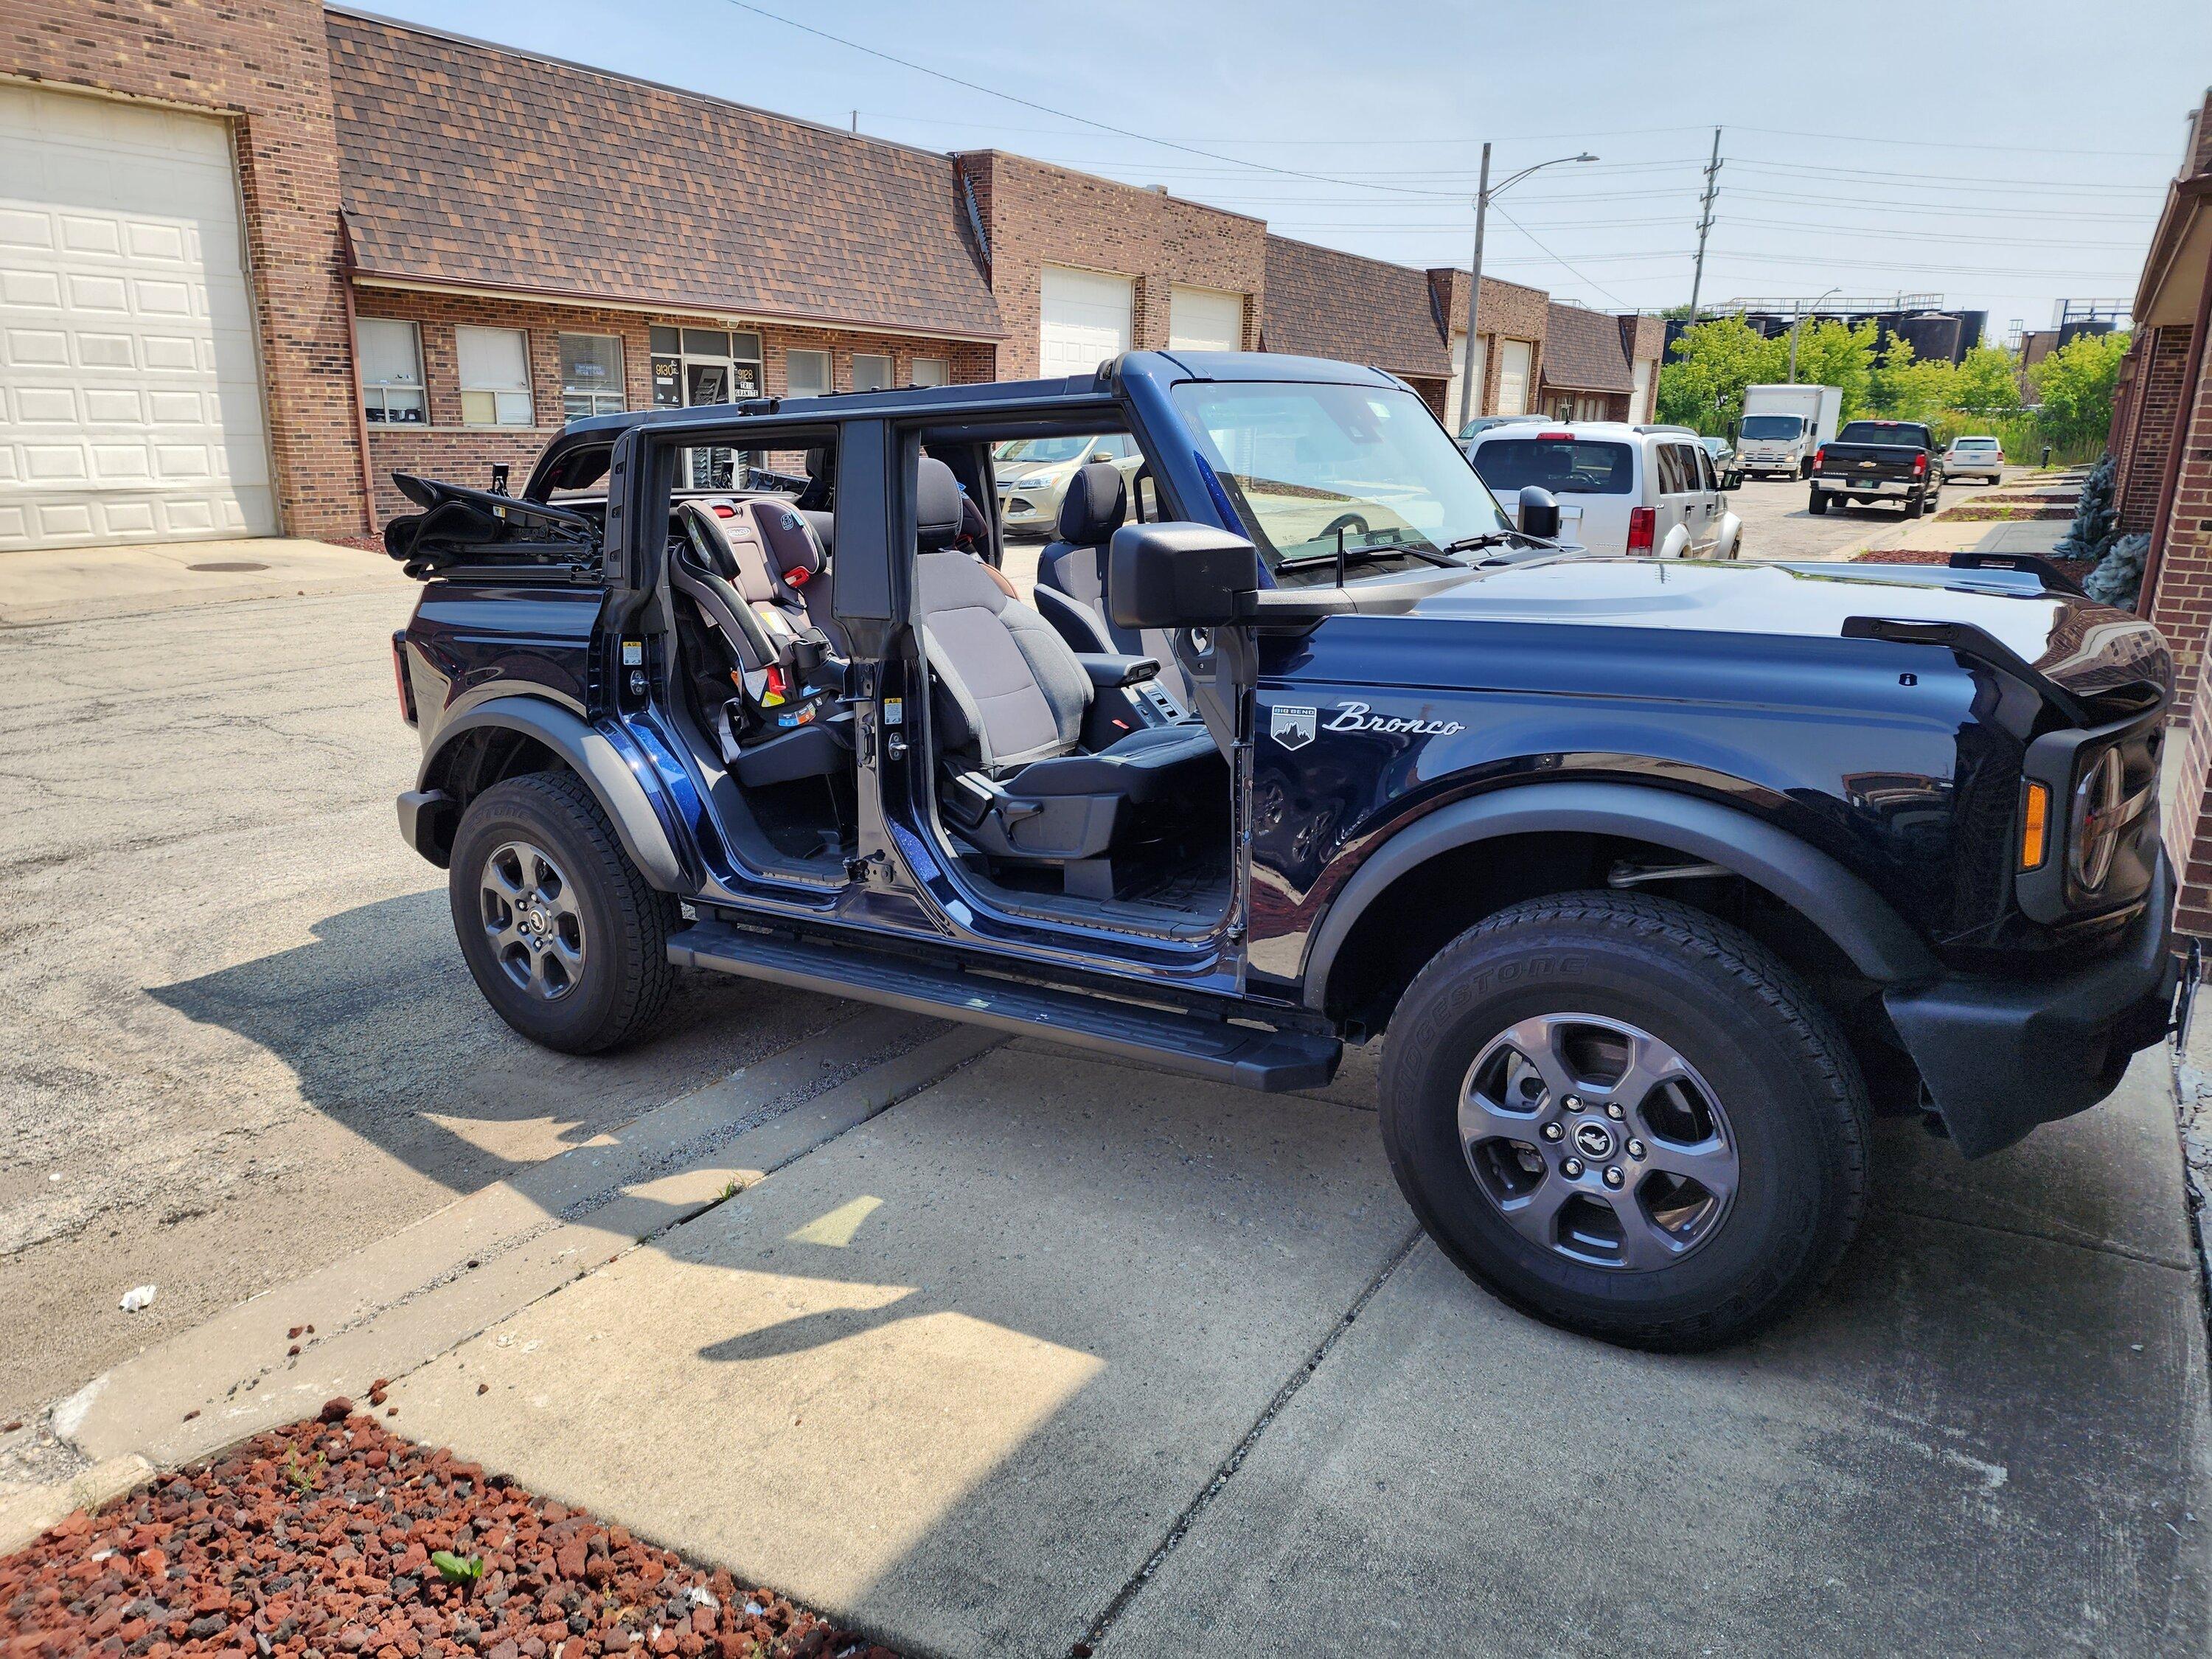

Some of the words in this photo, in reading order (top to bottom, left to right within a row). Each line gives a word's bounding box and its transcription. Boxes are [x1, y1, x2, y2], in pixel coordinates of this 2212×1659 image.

[655, 364, 673, 376] 9130
[737, 369, 754, 380] 9128
[735, 389, 758, 397] GRANITE
[1321, 701, 1467, 735] Bronco
